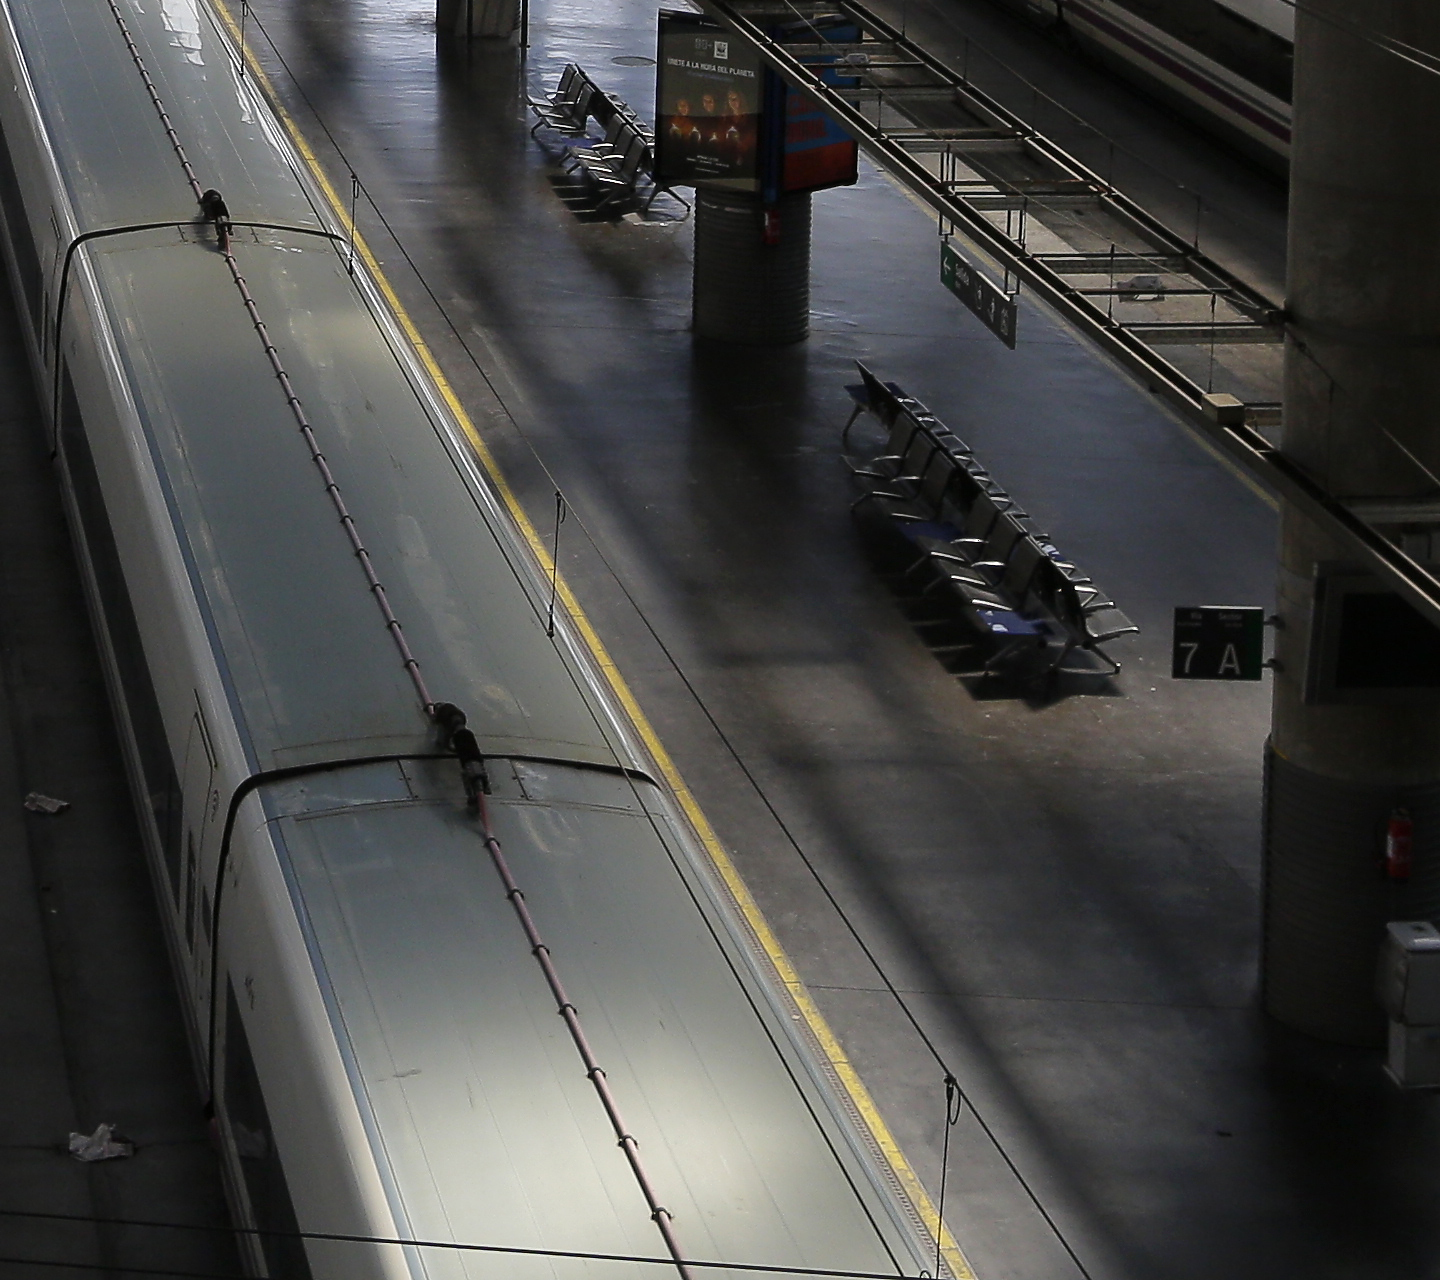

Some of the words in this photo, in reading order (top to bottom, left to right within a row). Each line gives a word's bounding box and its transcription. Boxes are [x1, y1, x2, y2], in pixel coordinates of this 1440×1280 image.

[691, 61, 700, 70] LA
[700, 62, 717, 72] HORA
[717, 65, 729, 75] DEL
[729, 67, 756, 79] PLANETA
[1179, 642, 1199, 674] 7
[1218, 643, 1241, 676] A
